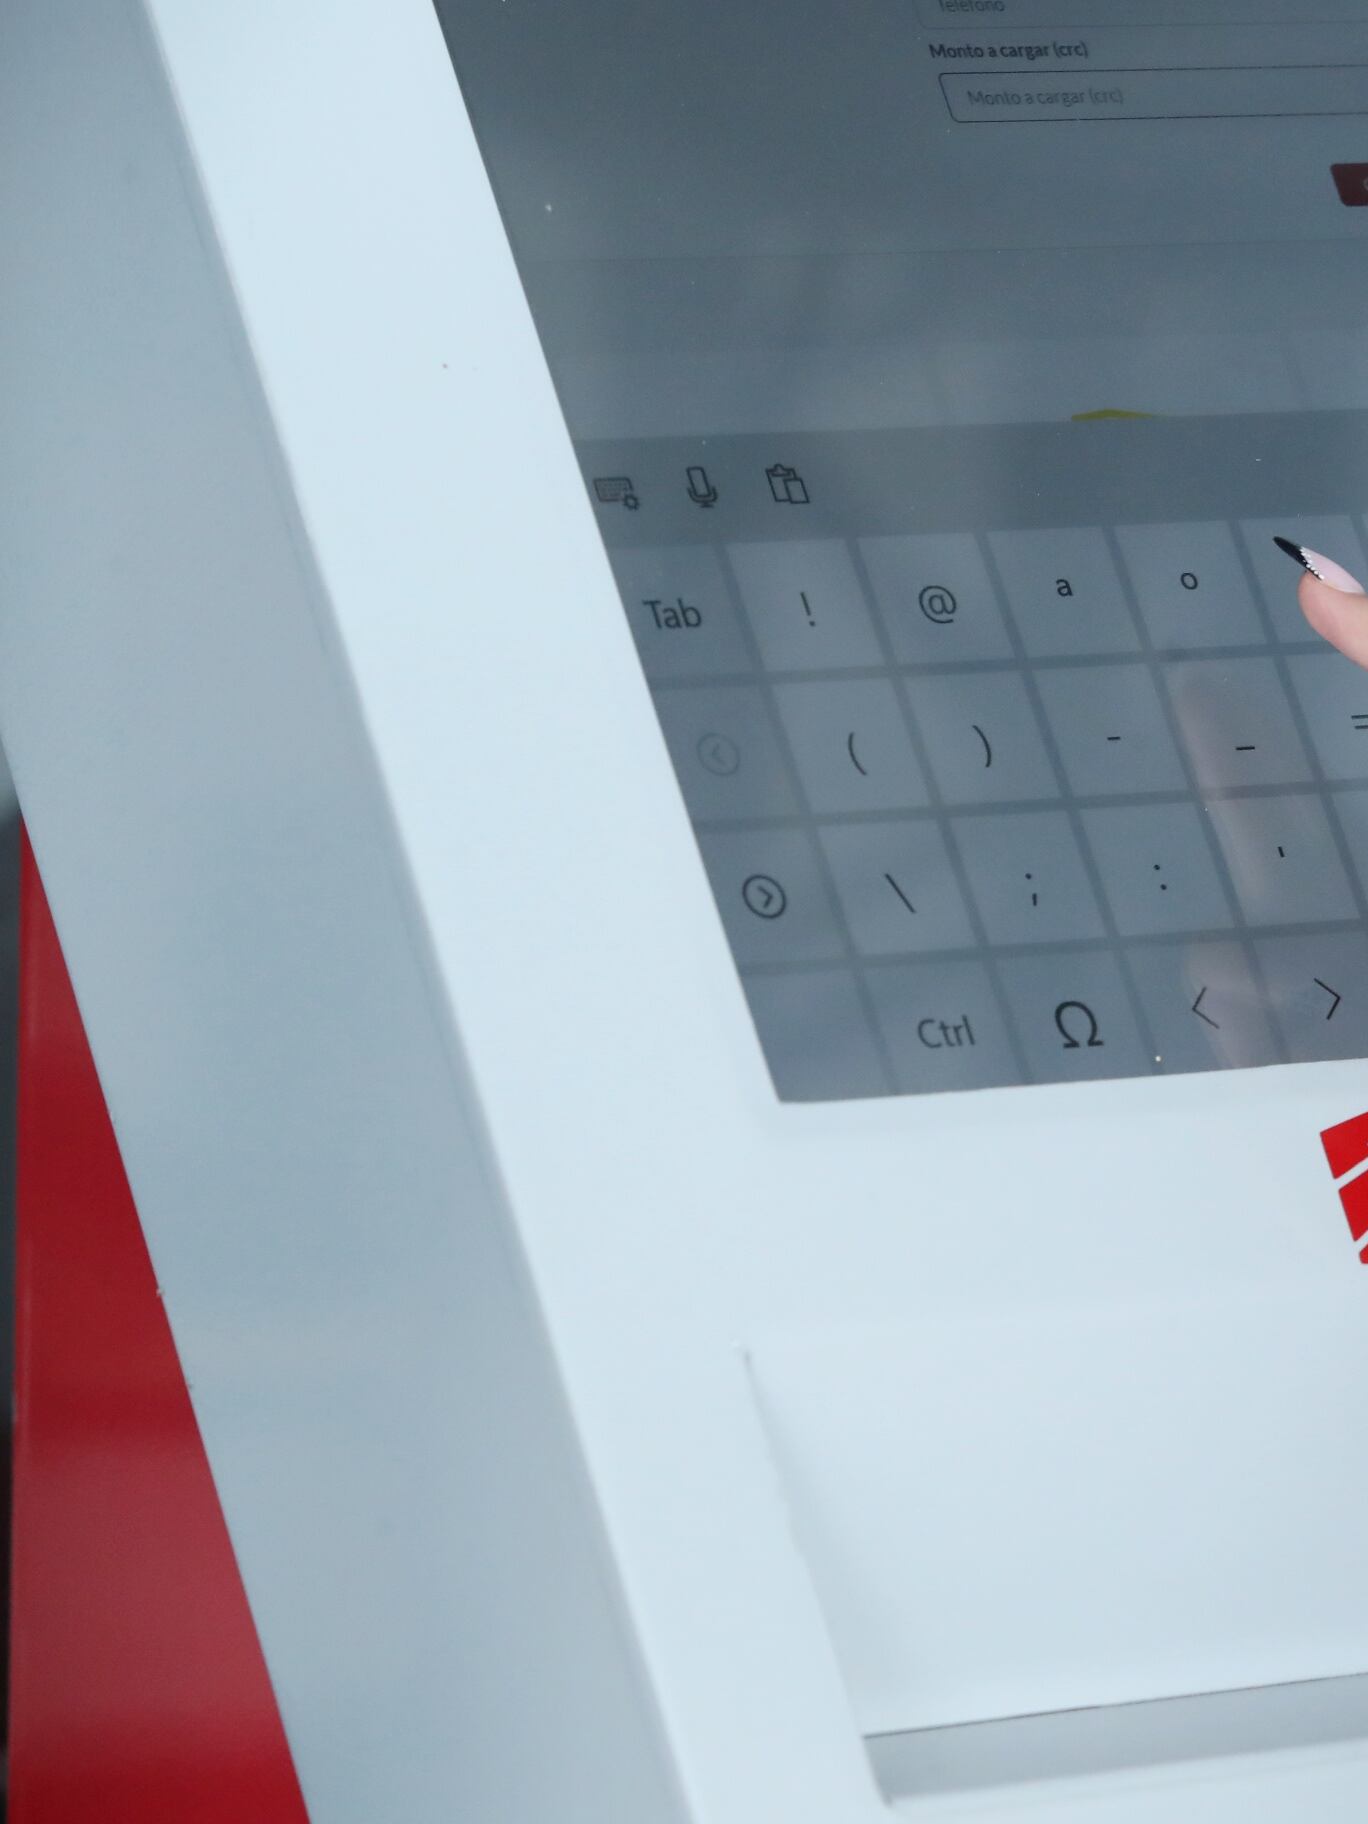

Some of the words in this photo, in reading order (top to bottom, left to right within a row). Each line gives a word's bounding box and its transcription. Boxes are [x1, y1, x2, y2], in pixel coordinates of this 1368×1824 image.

[929, 44, 985, 58] Monto
[988, 47, 998, 58] a
[1000, 45, 1050, 60] cargar
[1052, 41, 1089, 58] (crc)
[967, 90, 1021, 105] Monto
[1024, 93, 1034, 104] a
[1036, 92, 1086, 107] cargar
[642, 598, 703, 630] Tab
[800, 592, 816, 627] !
[918, 584, 957, 624] @
[848, 732, 867, 775] (
[972, 725, 992, 768] )
[916, 1014, 976, 1049] Ctrl
